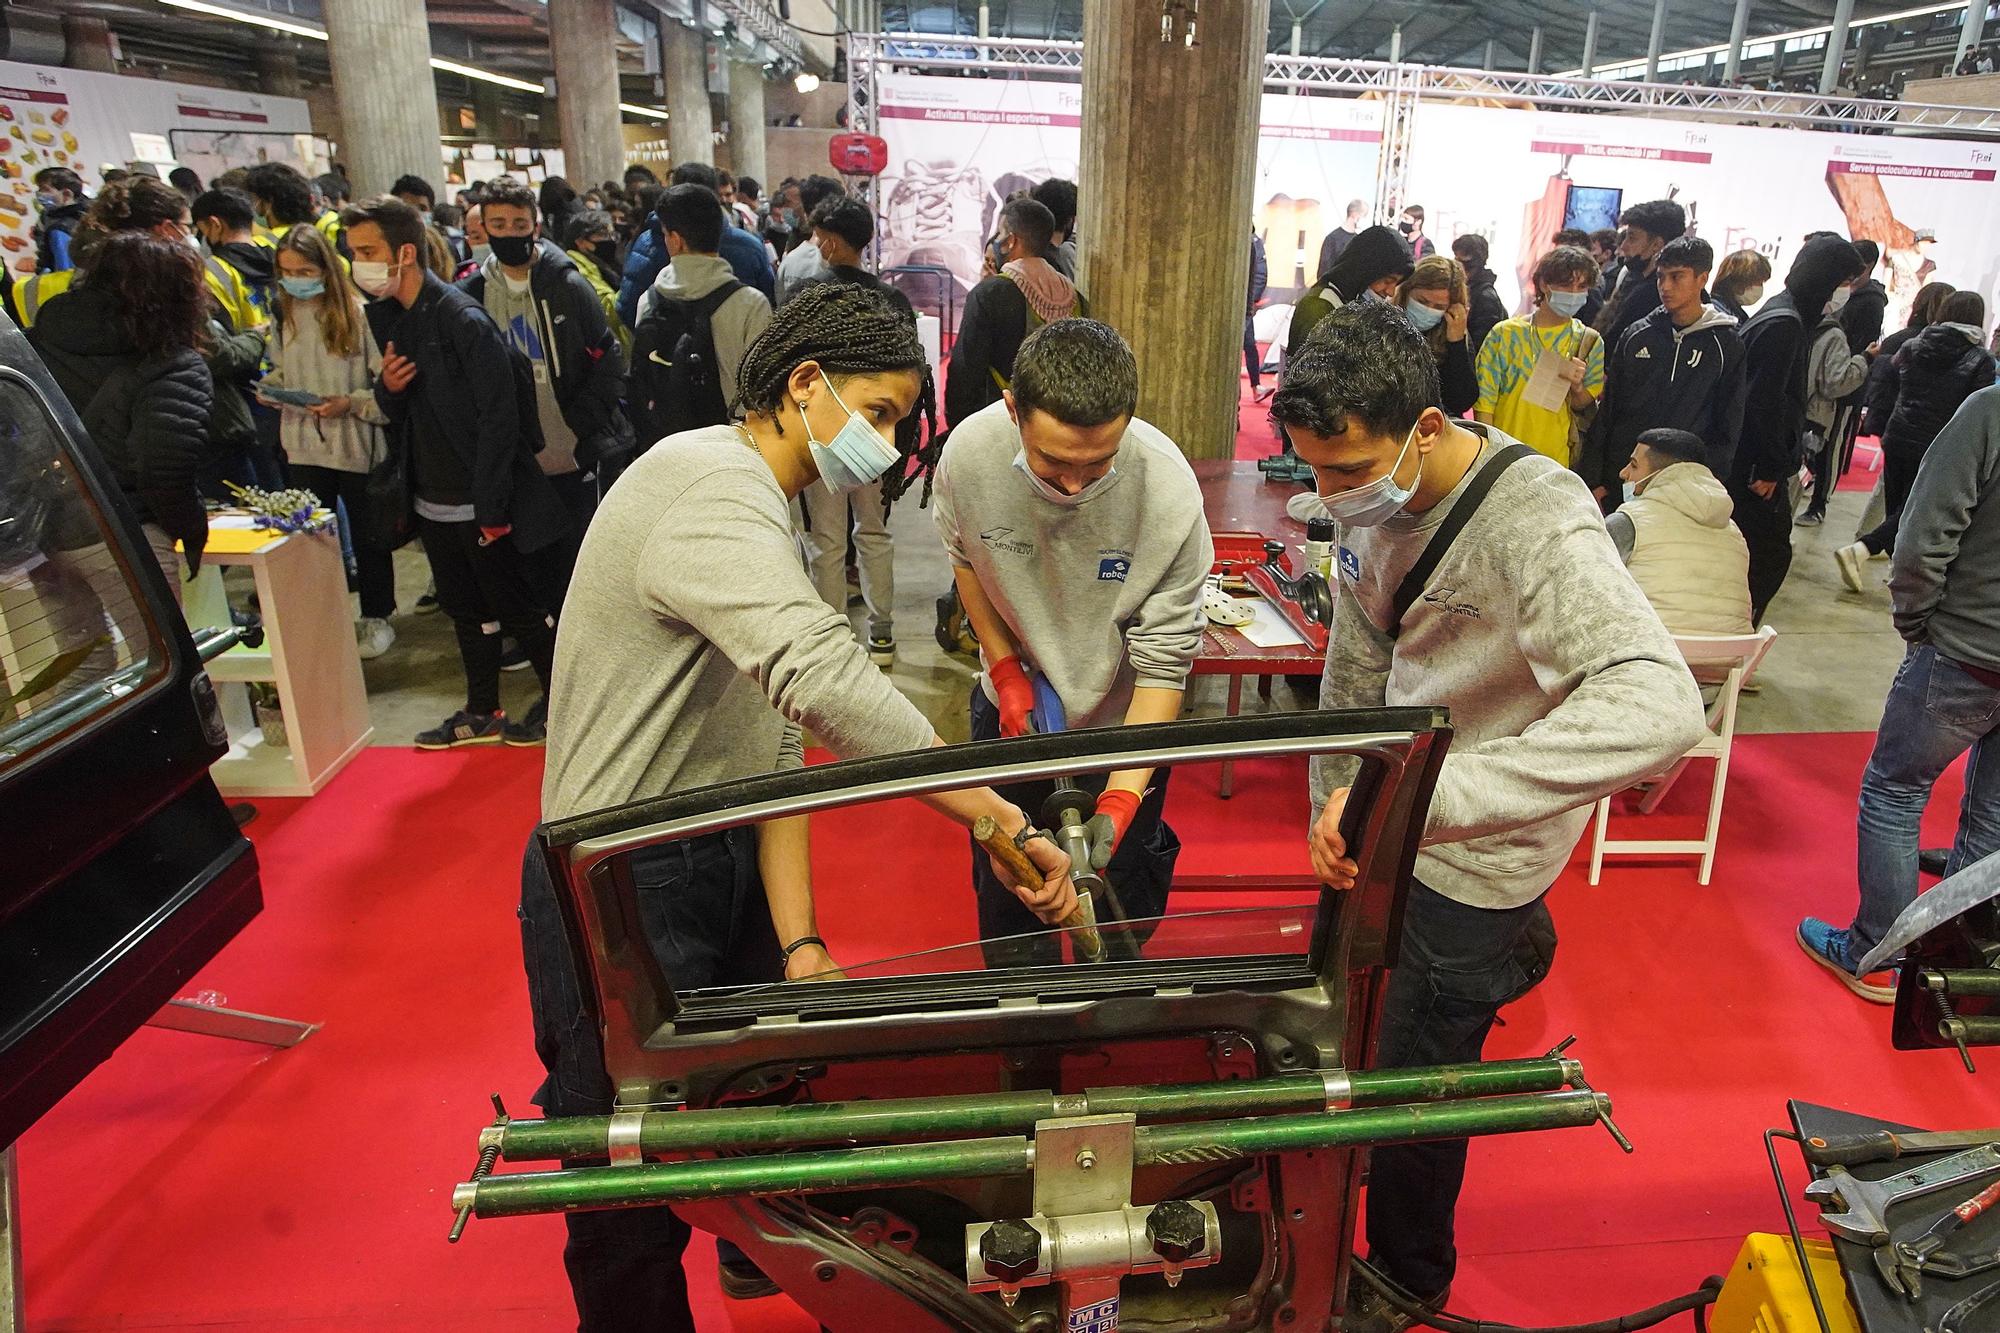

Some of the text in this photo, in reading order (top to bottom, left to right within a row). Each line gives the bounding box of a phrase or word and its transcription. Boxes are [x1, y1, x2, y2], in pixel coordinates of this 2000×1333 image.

[924, 108, 965, 121] Activitats
[1849, 163, 1875, 174] Serveis
[1876, 164, 1922, 177] socioculturals
[1933, 168, 1940, 177] la
[1940, 169, 1974, 179] comunitat
